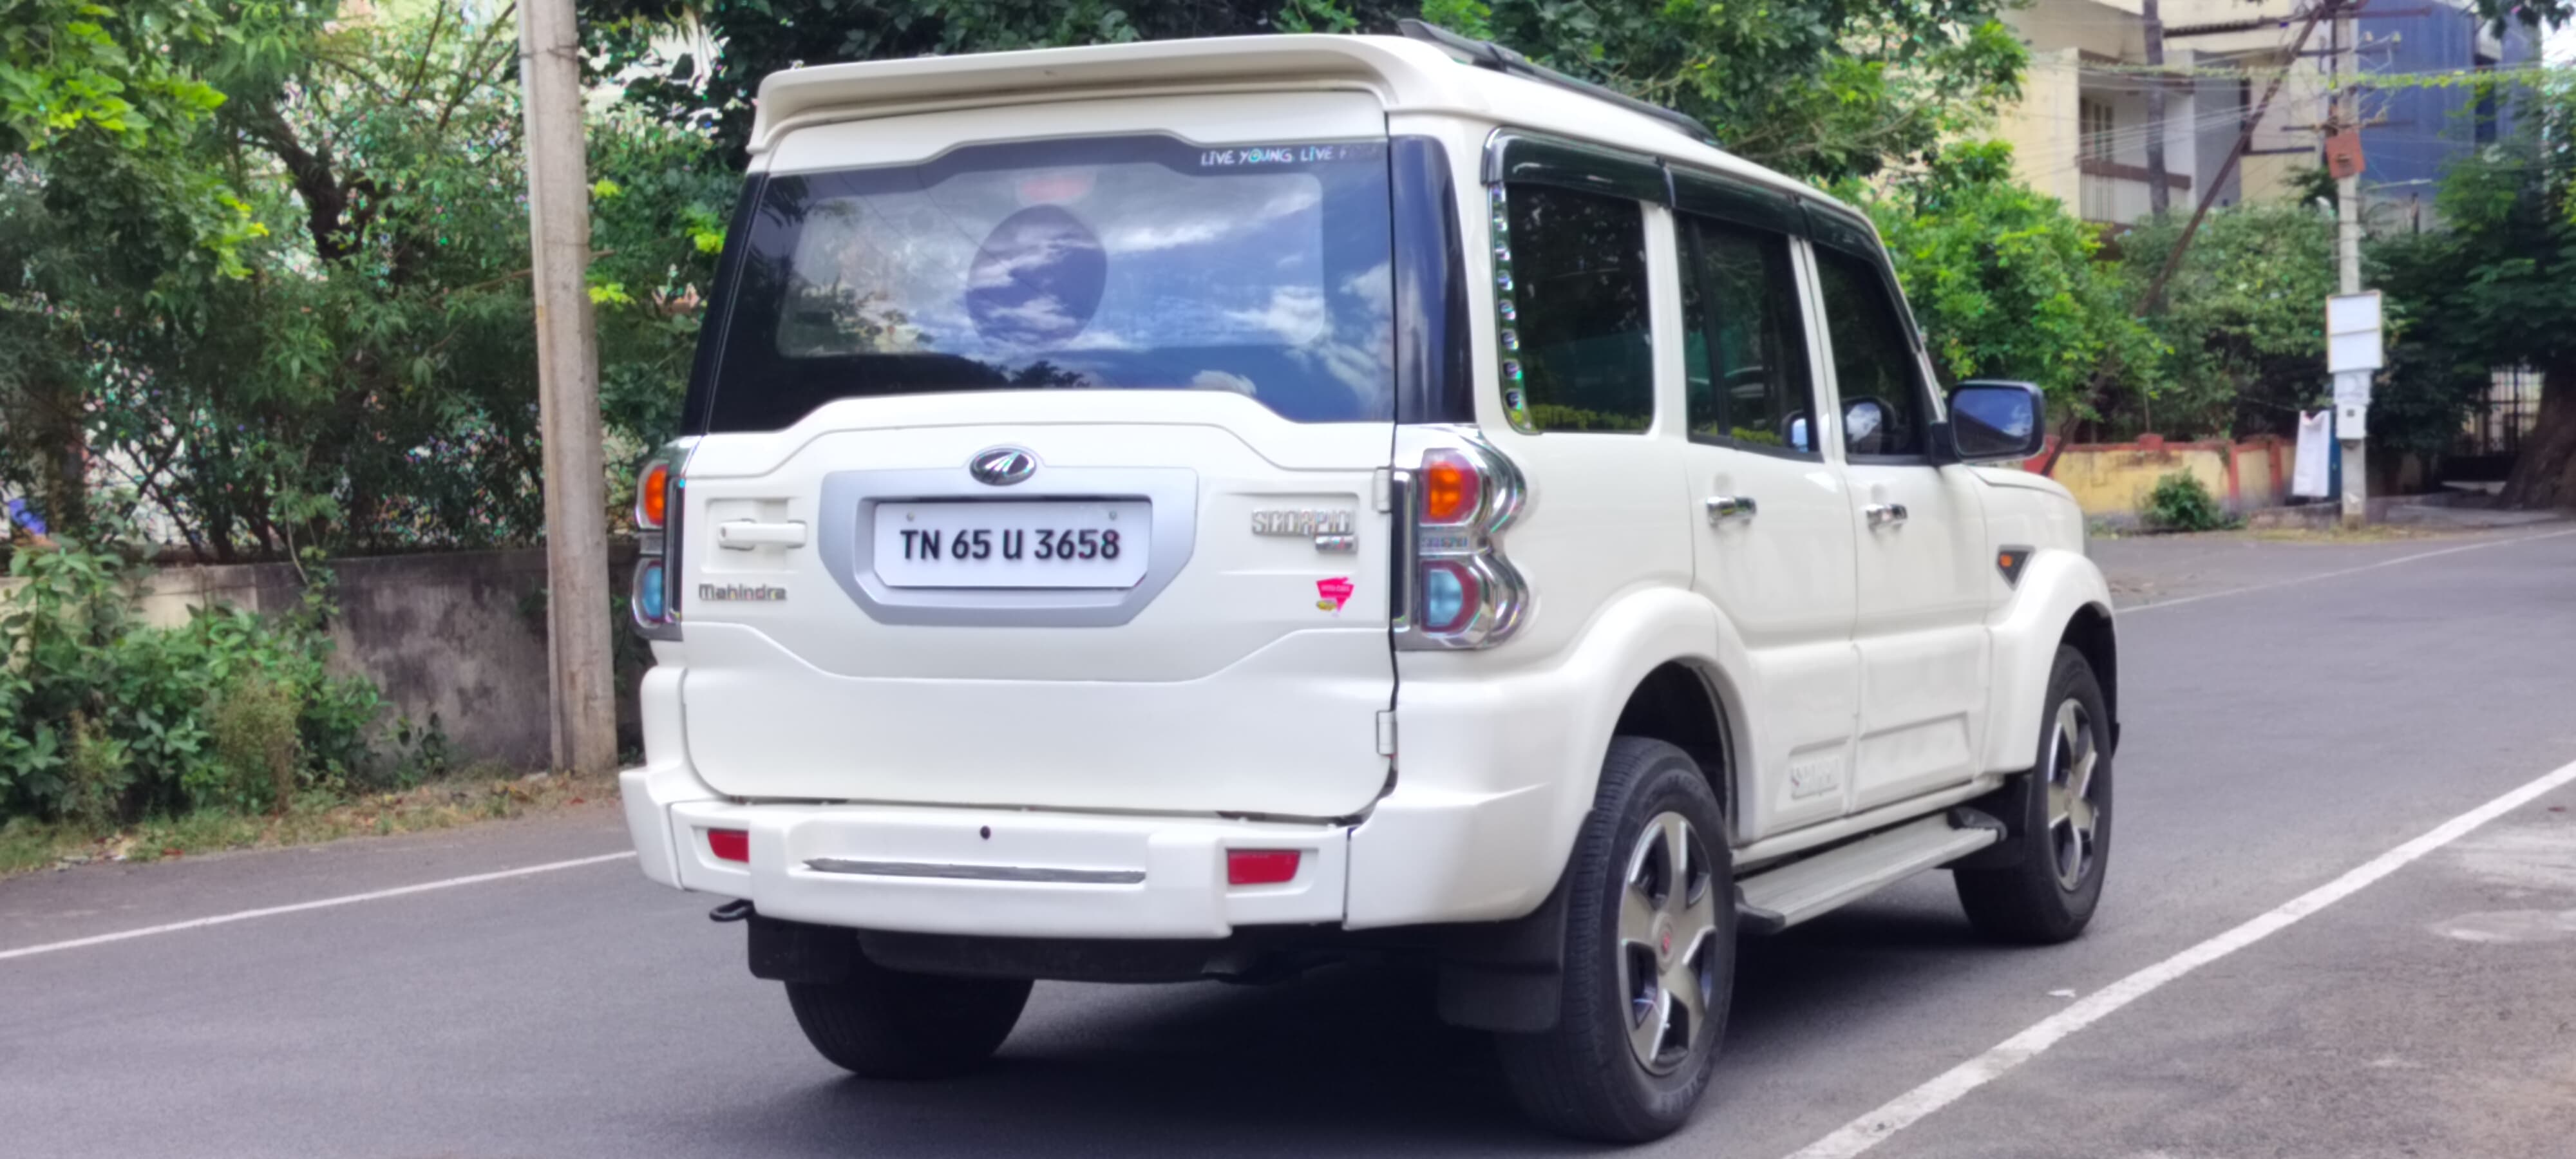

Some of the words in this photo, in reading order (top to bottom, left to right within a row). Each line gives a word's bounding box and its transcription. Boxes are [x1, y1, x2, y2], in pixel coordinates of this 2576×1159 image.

[1200, 149, 1235, 166] LIVE
[1238, 147, 1293, 164] YOUNG
[1300, 146, 1334, 162] LIVE
[900, 529, 941, 560] TN
[951, 529, 992, 560] 65
[1002, 529, 1023, 560] U
[1034, 529, 1121, 560] 3658
[699, 583, 787, 601] Mahindra
